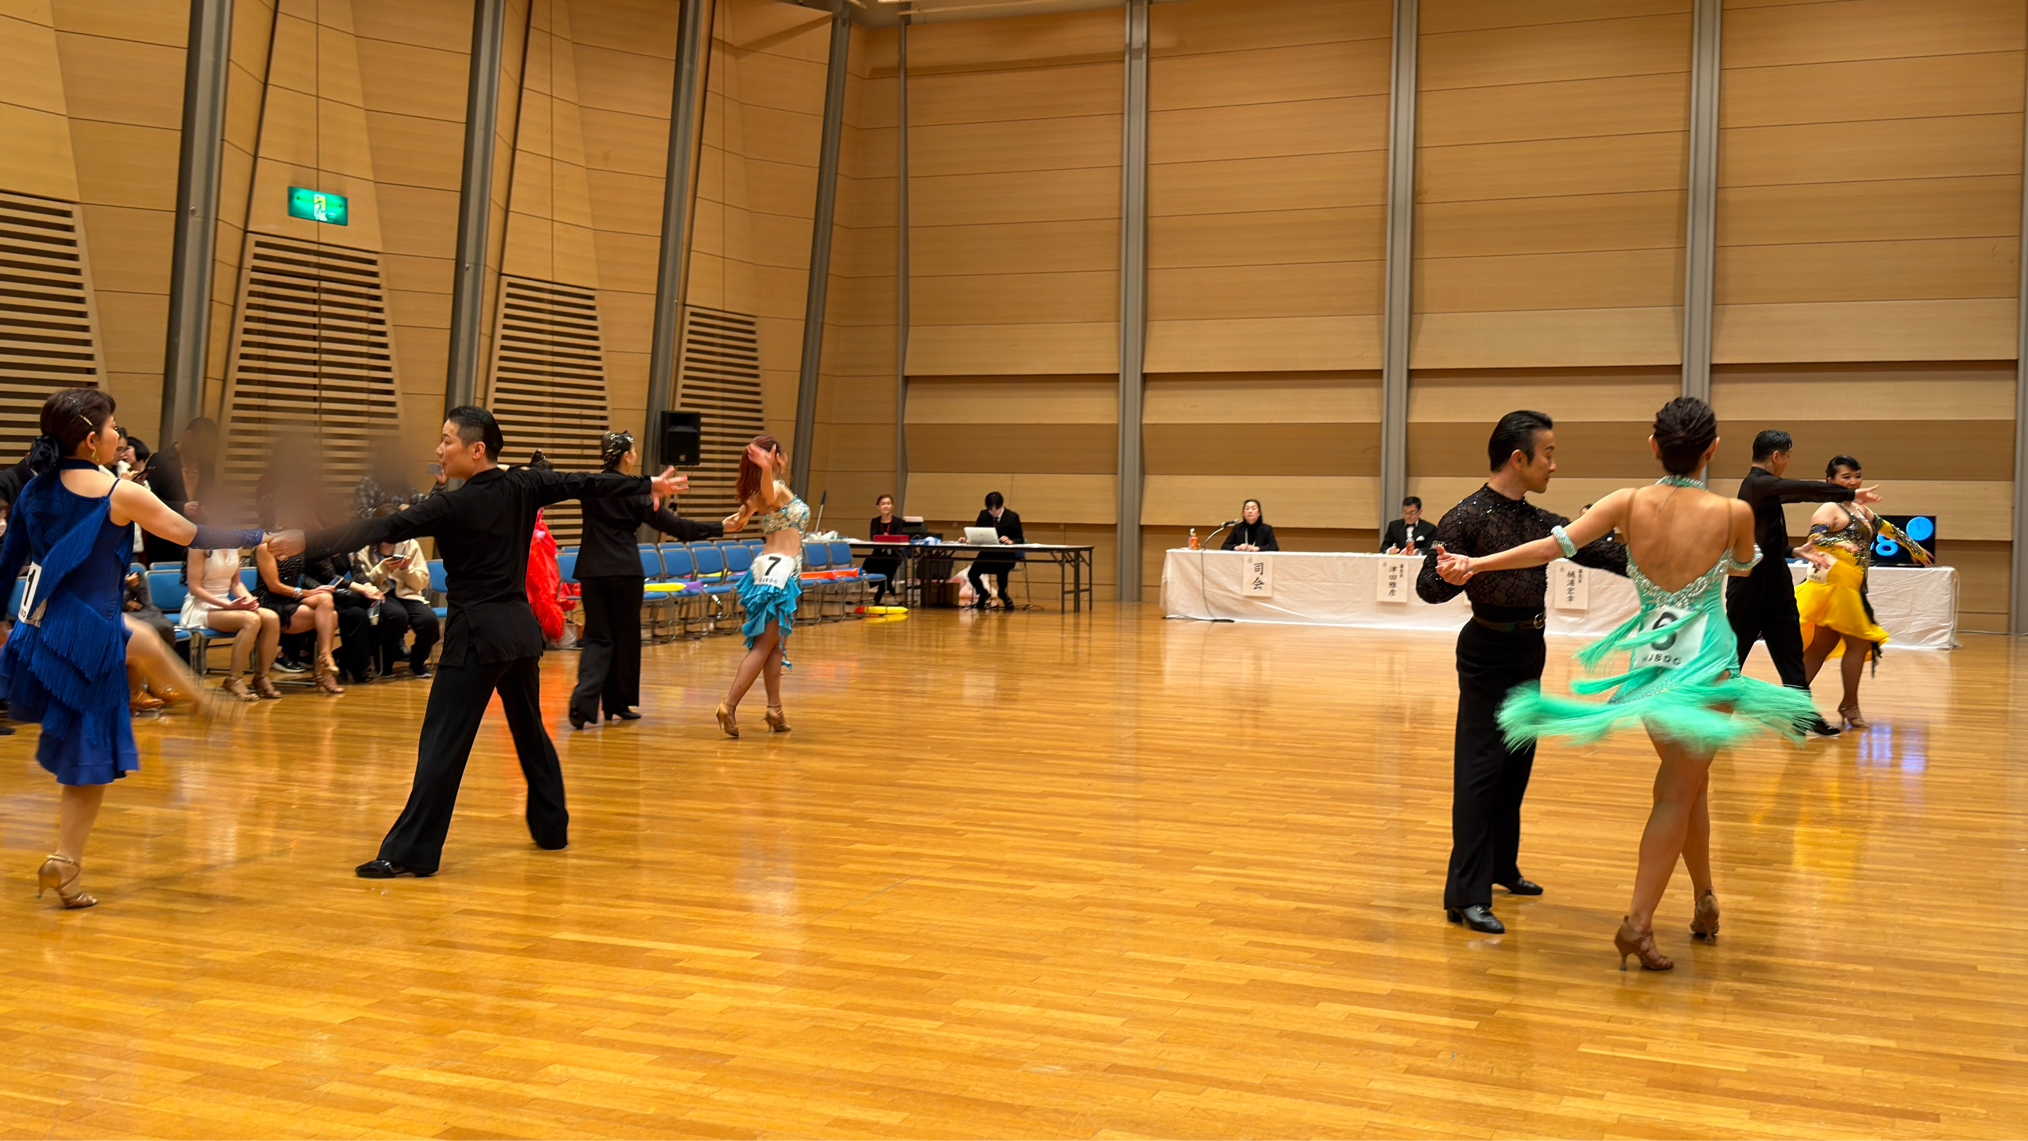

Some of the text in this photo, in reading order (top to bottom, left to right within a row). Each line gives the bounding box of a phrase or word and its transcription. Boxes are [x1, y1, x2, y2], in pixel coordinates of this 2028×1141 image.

[765, 556, 782, 576] 7
[1252, 562, 1265, 590] 司会
[23, 569, 36, 606] 1
[1651, 611, 1677, 651] 6
